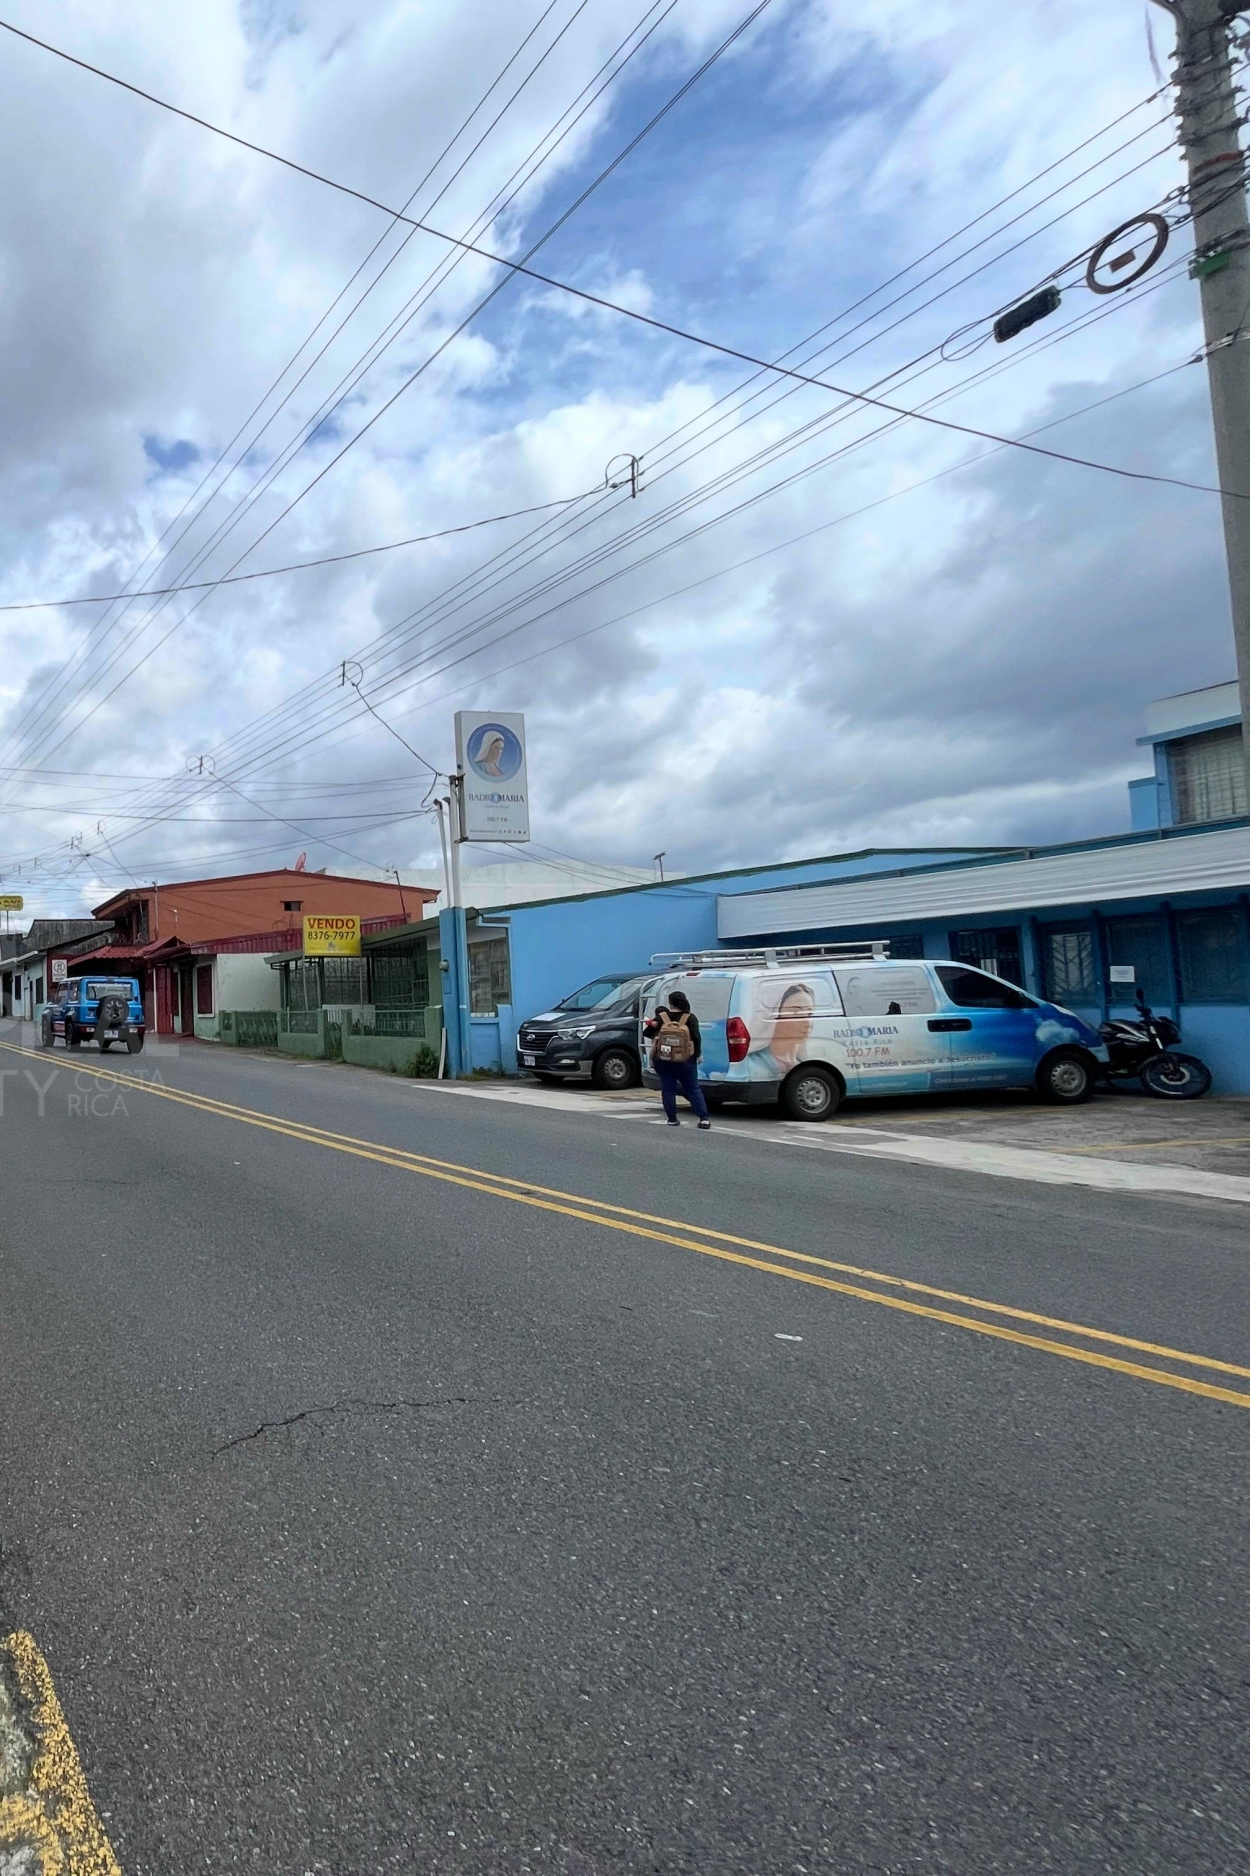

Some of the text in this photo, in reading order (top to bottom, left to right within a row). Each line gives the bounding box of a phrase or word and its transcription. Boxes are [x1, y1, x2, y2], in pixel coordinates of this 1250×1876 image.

[307, 918, 356, 929] VENDO
[307, 931, 356, 940] 8376-7977
[833, 1026, 899, 1038] RADIO MARIA
[846, 1047, 891, 1057] 100.7 FM
[901, 1057, 936, 1066] anuncio
